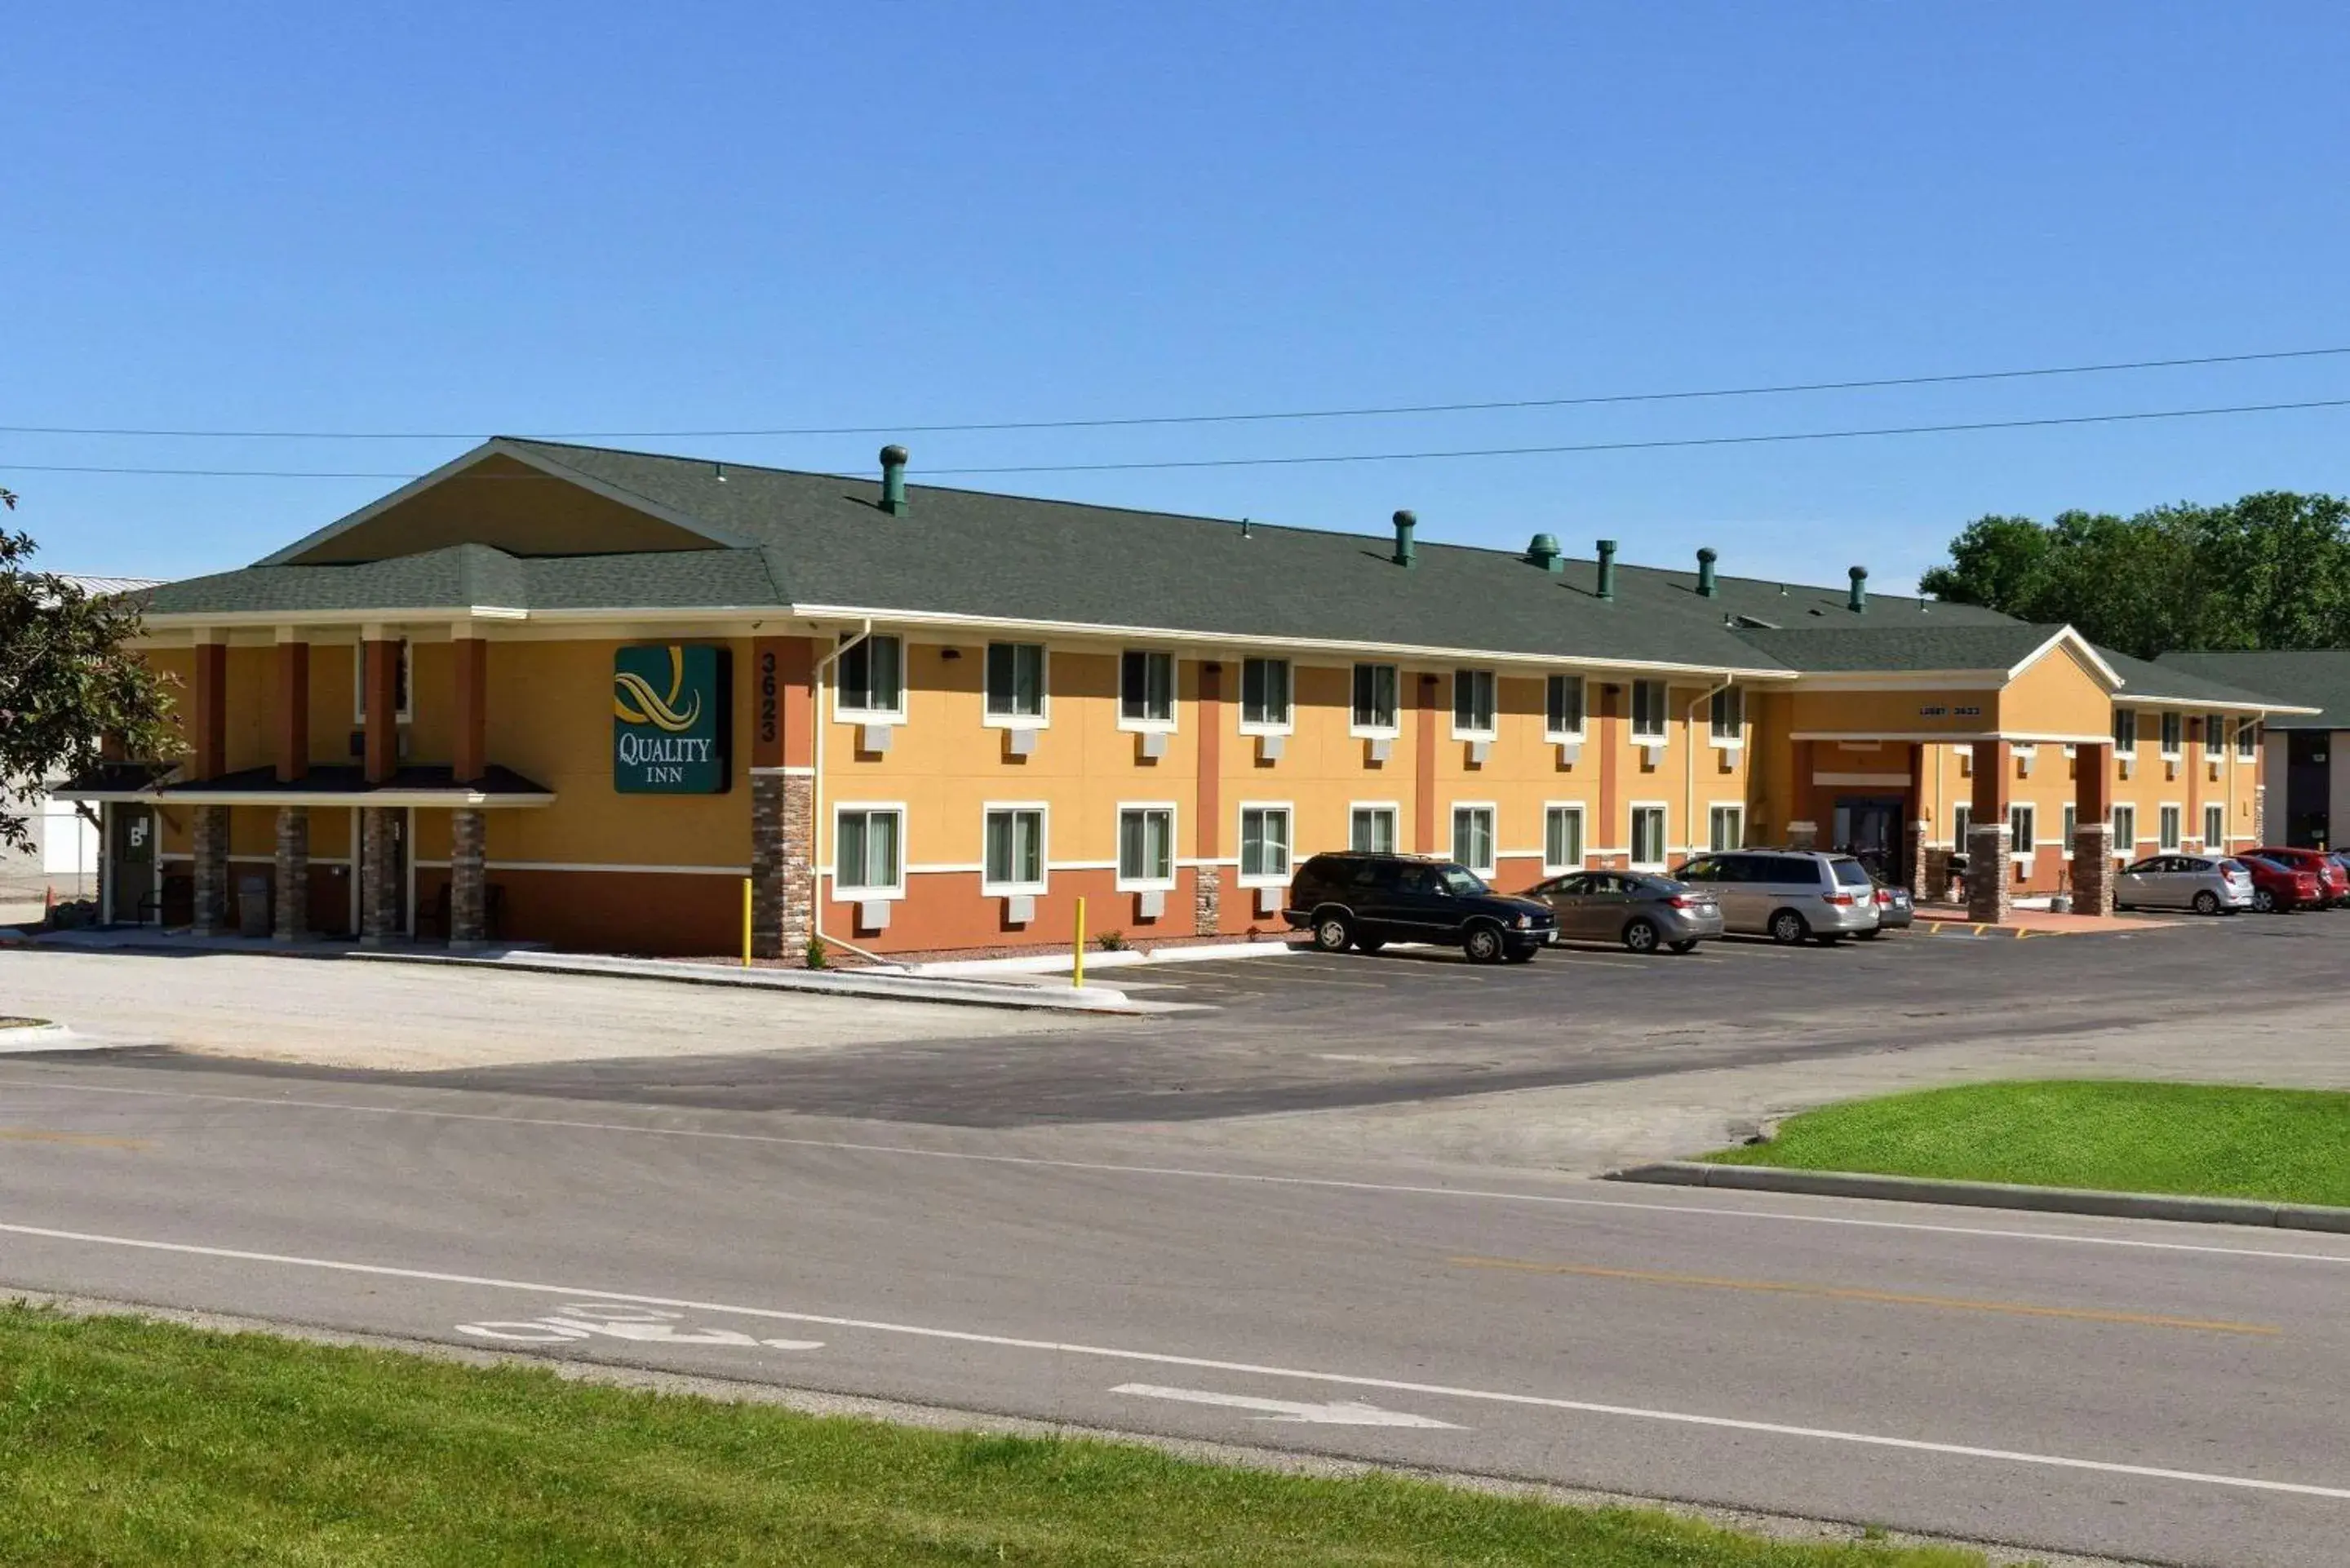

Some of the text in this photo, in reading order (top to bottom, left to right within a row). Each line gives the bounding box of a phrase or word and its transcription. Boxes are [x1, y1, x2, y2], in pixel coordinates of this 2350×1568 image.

[761, 652, 776, 742] 3623
[619, 733, 711, 766] QUALITY
[645, 767, 683, 782] INN
